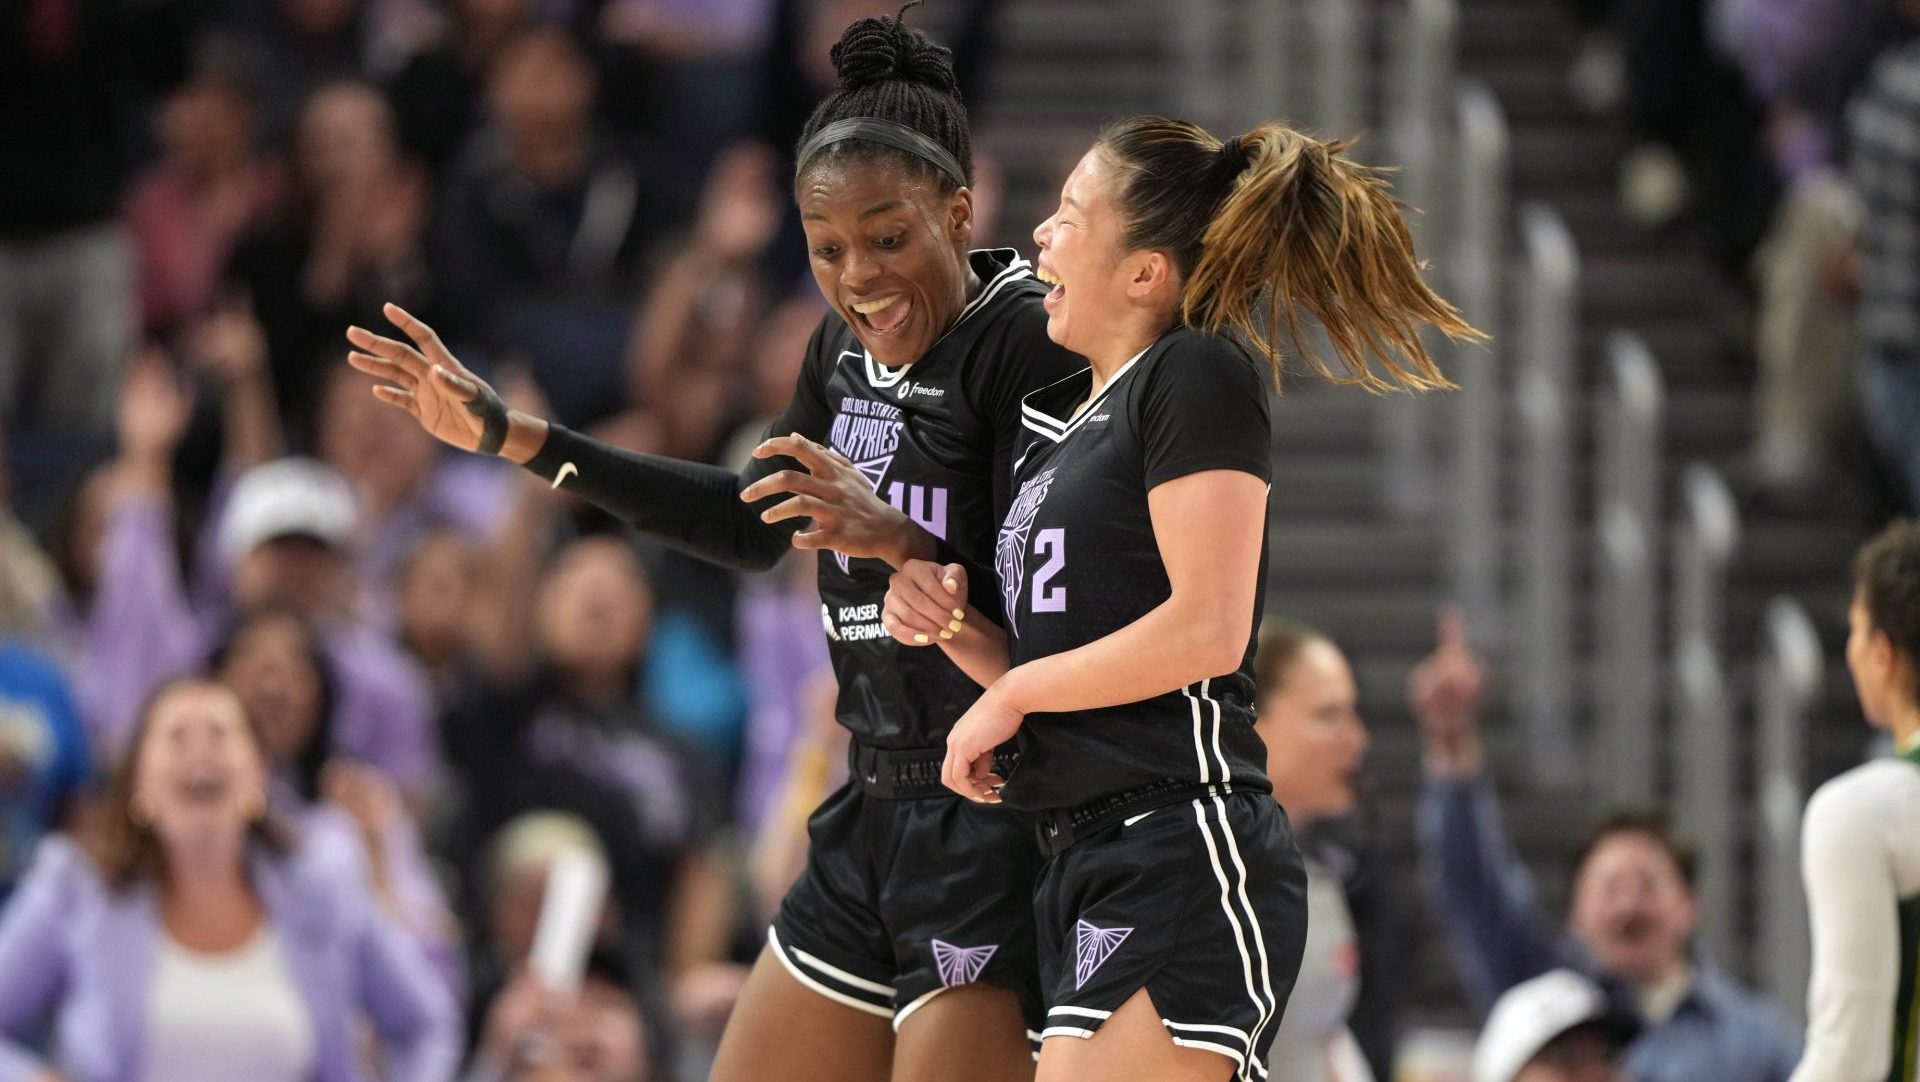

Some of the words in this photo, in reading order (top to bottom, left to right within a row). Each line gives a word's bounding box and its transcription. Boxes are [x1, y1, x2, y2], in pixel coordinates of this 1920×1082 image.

[909, 382, 945, 398] freedom
[841, 397, 870, 416] GOLDEN
[870, 401, 903, 420] STATE
[1031, 527, 1067, 613] 2
[839, 603, 879, 623] KAISER
